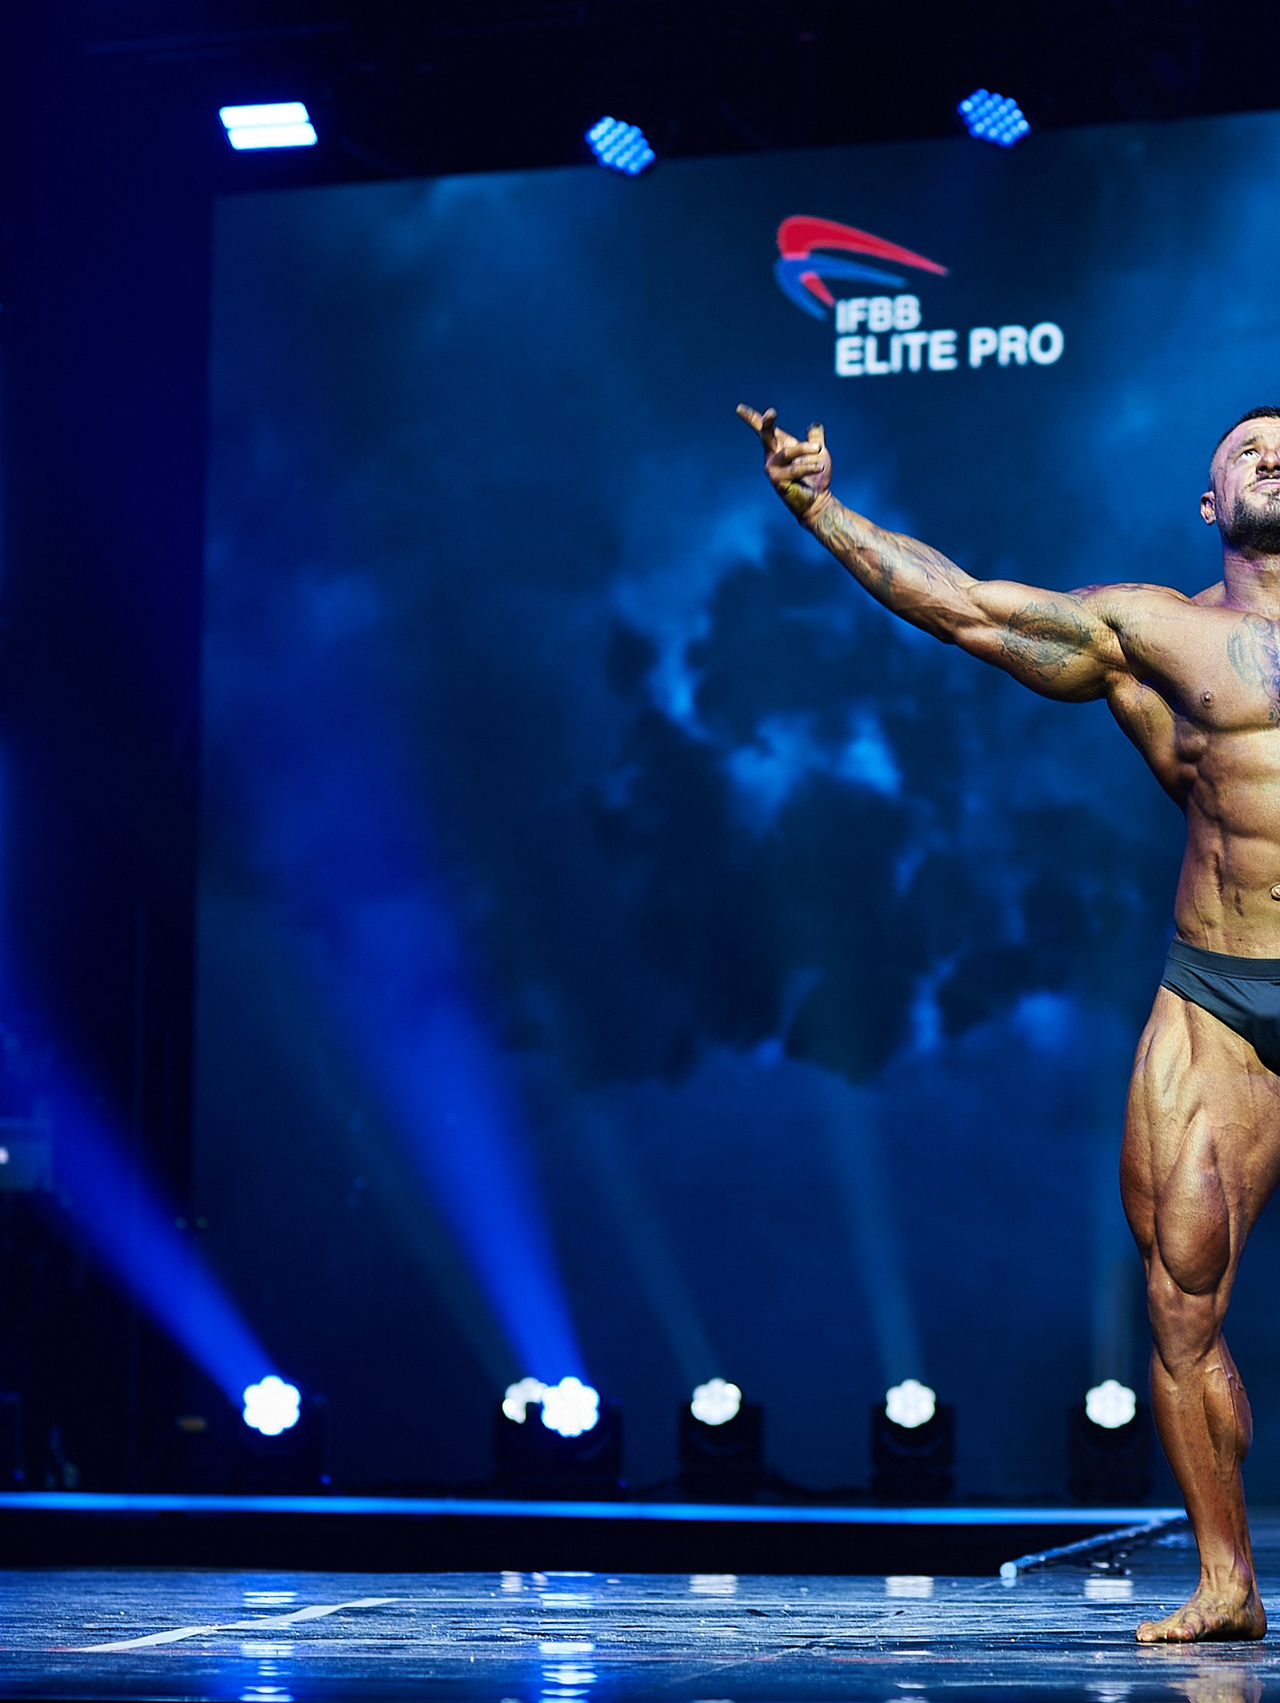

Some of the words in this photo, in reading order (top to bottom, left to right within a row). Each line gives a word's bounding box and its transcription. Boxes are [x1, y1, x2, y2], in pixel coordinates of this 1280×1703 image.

[835, 294, 921, 334] IFBB
[835, 329, 958, 377] ELITE
[968, 322, 1064, 369] PRO
